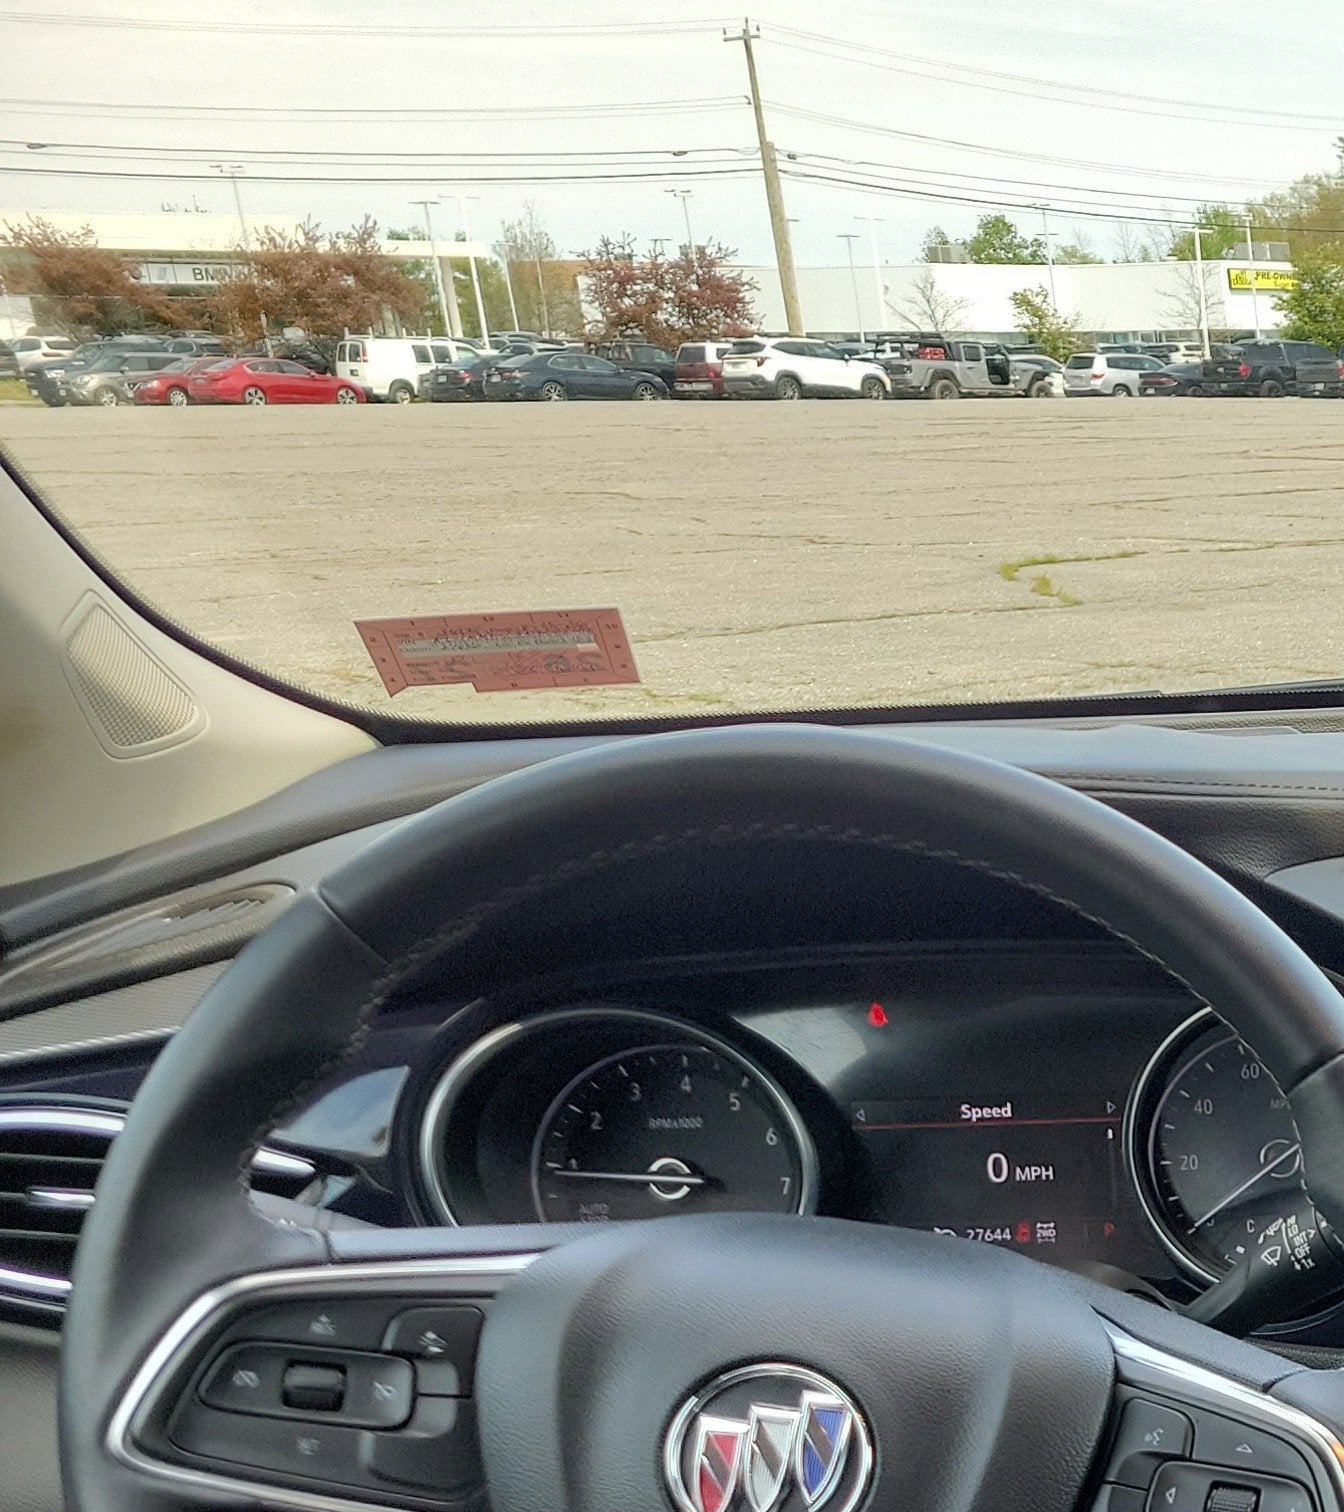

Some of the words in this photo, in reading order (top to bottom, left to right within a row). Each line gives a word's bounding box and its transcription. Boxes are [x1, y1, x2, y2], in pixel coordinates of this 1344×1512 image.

[1240, 1063, 1260, 1079] 60
[729, 1092, 741, 1111] 5
[1194, 1099, 1213, 1115] 40
[1270, 1099, 1290, 1110] MP
[589, 1111, 602, 1131] 2
[960, 1101, 1013, 1123] Speed
[765, 1127, 778, 1147] 6
[986, 1152, 1009, 1183] 0
[1015, 1165, 1055, 1182] MPH
[1180, 1154, 1199, 1171] 20
[781, 1177, 792, 1196] 7
[966, 1227, 1012, 1241] 27644
